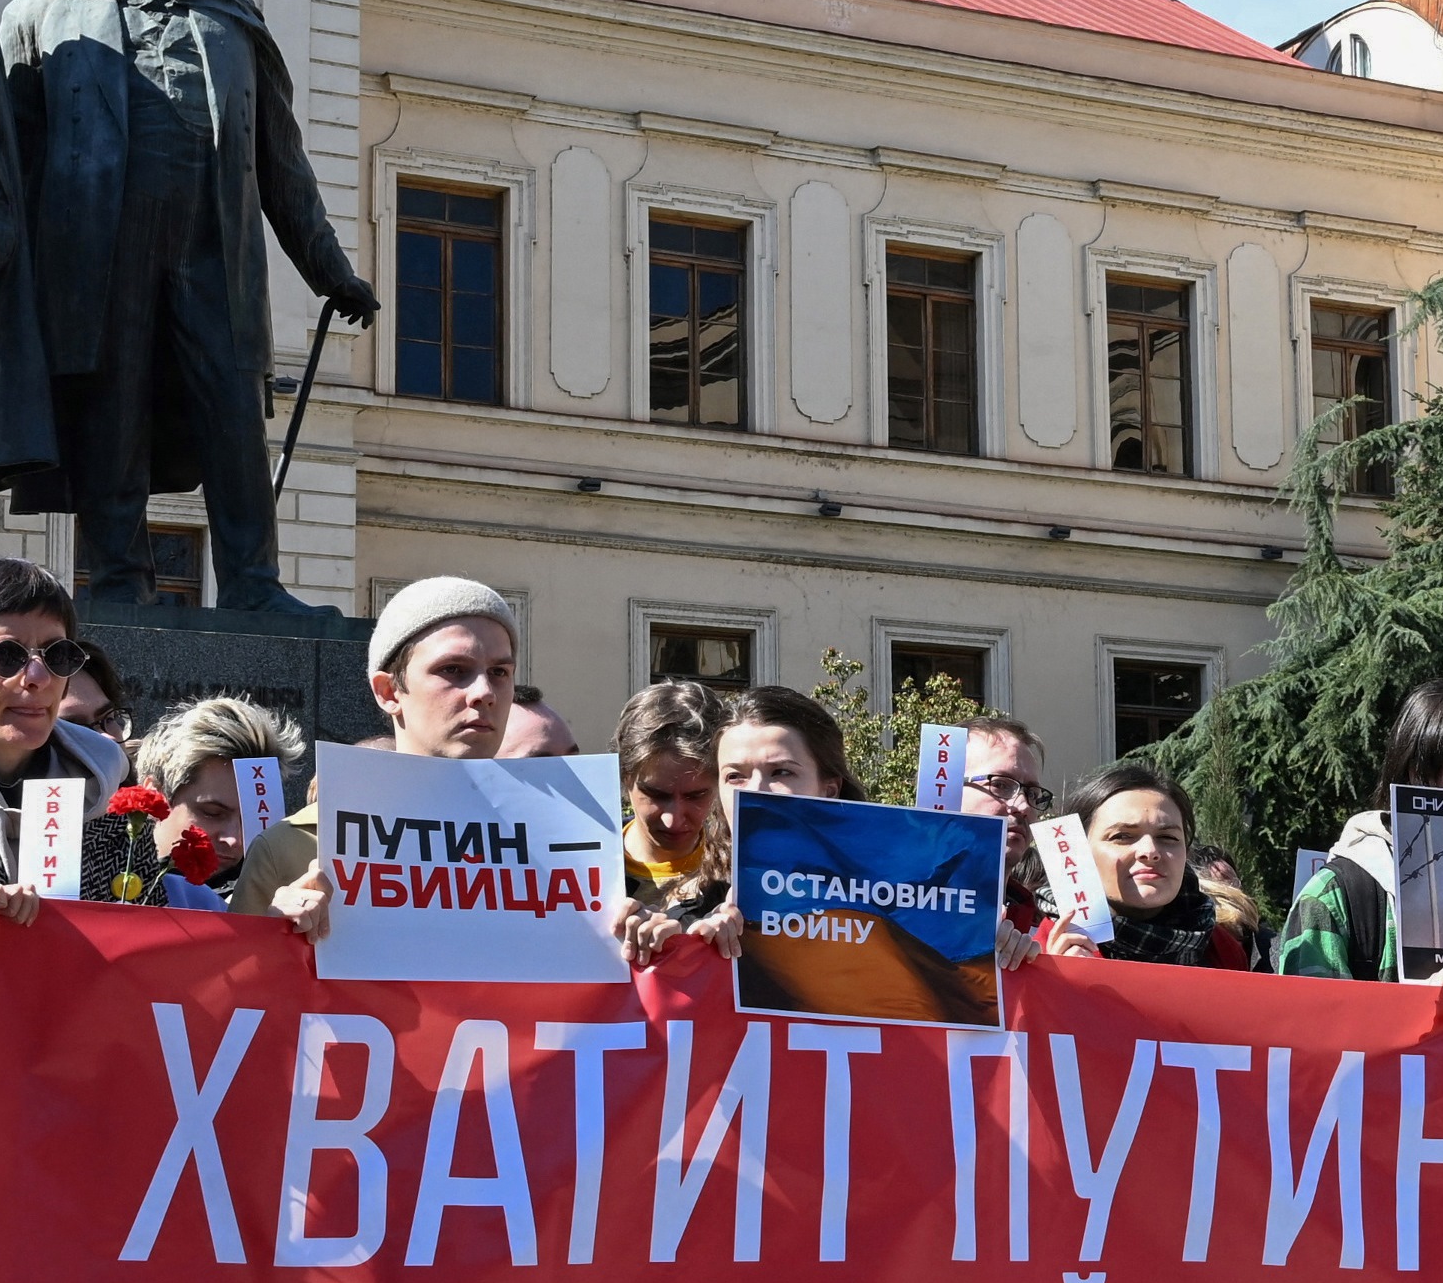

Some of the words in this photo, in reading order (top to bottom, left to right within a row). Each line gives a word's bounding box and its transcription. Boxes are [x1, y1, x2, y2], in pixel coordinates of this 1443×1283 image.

[251, 766, 270, 830] ХВАТ
[933, 733, 951, 811] ХВАТ
[43, 786, 61, 888] ХВАТИТ
[336, 810, 529, 865] ПУТИН
[332, 853, 603, 919] УБИЙЦА!
[760, 869, 977, 915] ОСТАНОВИТЕ
[1052, 825, 1090, 921] ХВАТИТ
[761, 908, 875, 944] ВОЙНУ
[117, 1001, 883, 1268] ХВАТИТ
